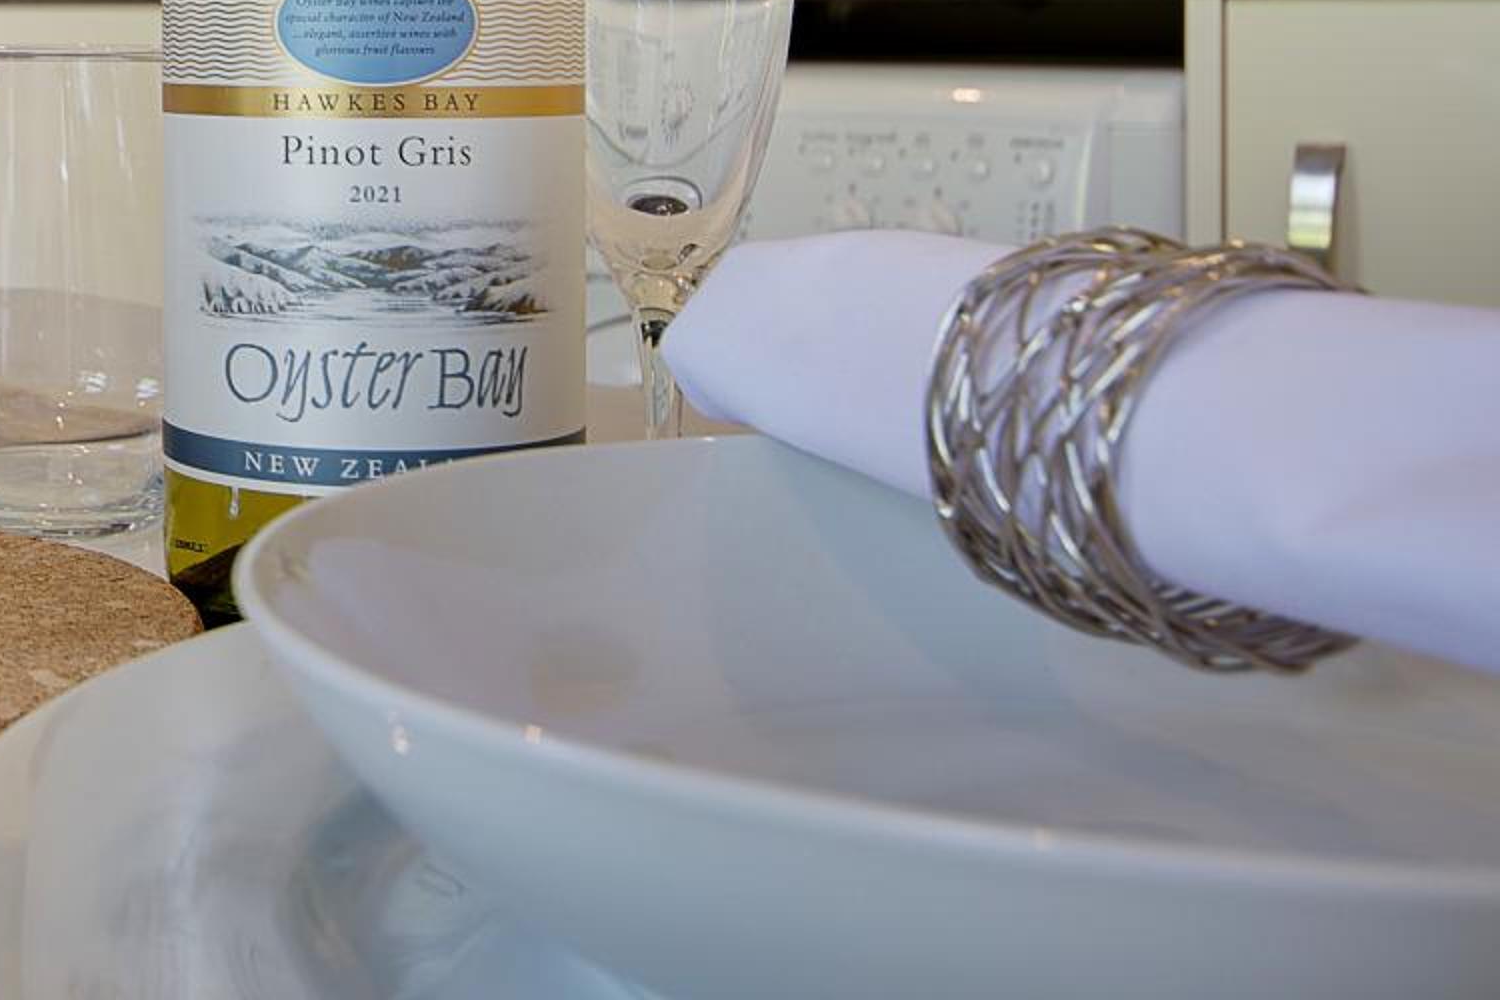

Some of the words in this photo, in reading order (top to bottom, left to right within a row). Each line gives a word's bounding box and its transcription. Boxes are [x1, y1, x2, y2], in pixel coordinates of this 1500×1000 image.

[393, 11, 419, 22] New
[421, 11, 465, 22] Zealand
[272, 93, 405, 112] HAWKES
[424, 93, 482, 111] BAY
[282, 135, 382, 166] Pinot
[398, 135, 472, 167] Gris
[349, 185, 402, 203] 2021
[225, 342, 422, 422] Oyster
[427, 347, 528, 417] Bay
[244, 451, 320, 477] NEW
